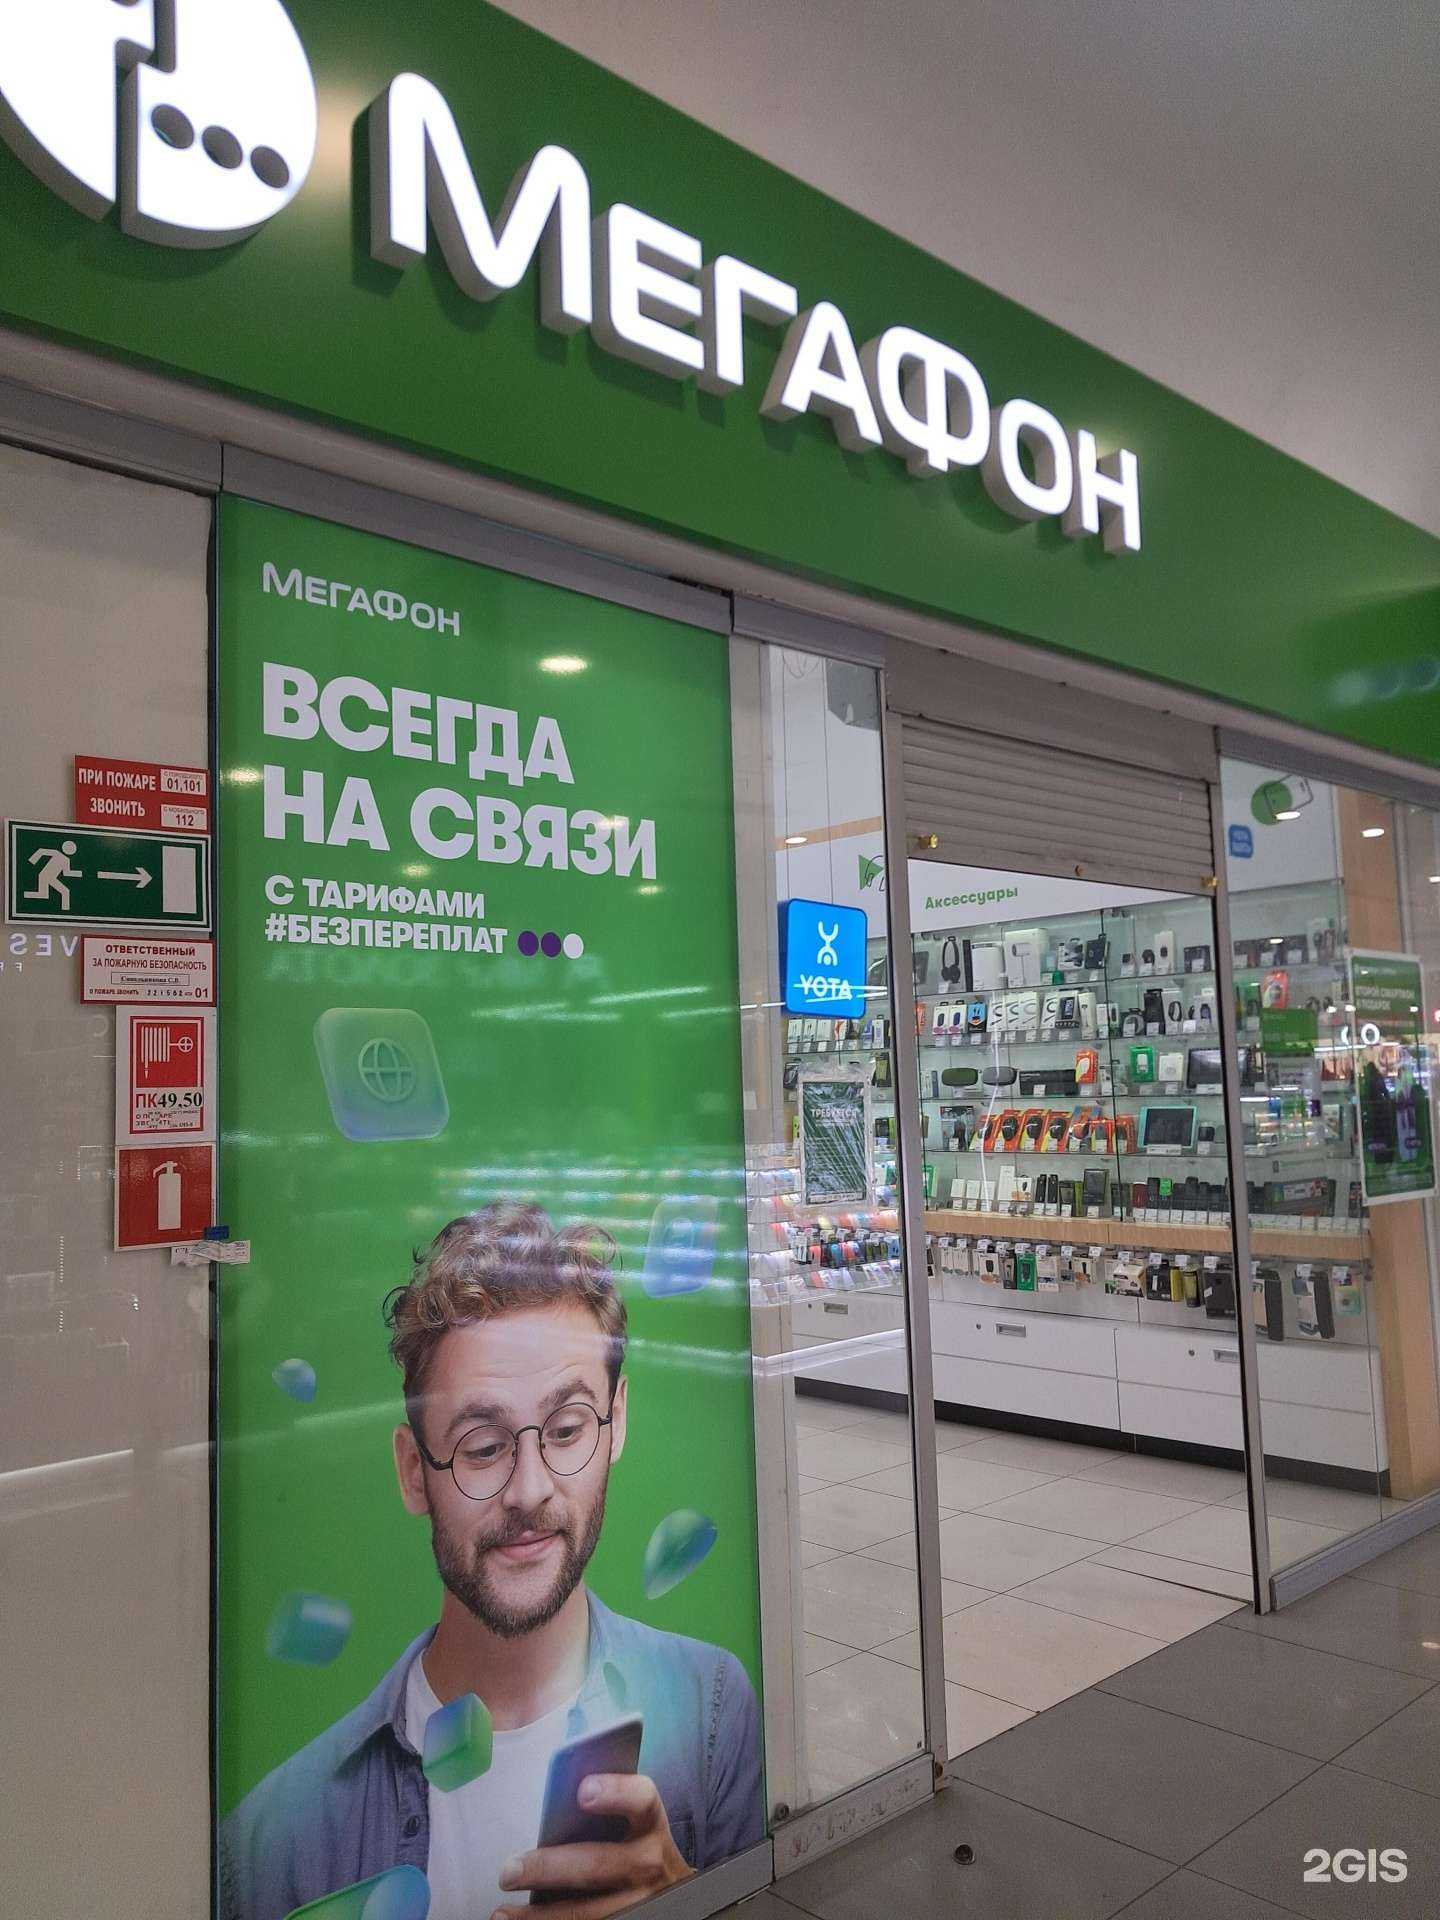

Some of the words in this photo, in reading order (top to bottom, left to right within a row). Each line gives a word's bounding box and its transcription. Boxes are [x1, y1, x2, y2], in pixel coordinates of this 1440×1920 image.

[263, 661, 575, 787] ВСЕГДА
[78, 767, 103, 786] ПРИ
[106, 771, 156, 791] ПОЖАРЕ
[167, 778, 201, 793] 01,101
[90, 797, 146, 817] ЗВОНИТЬ
[175, 814, 194, 826] 112
[263, 764, 390, 851] НА
[410, 787, 657, 880] СВЯЗИ
[264, 874, 294, 905] С
[302, 877, 485, 919] ТАРИФАМИ
[925, 887, 1018, 909] Аксессуары
[265, 912, 508, 954] #БЕЗПЕРЕПЛАТ
[105, 944, 196, 956] ОТВЕТСТВЕННЫЙ
[92, 958, 103, 967] ЗА
[104, 958, 148, 969] ПОЖАРНУЮ
[149, 960, 207, 971] БЕЗОПАСНОСТЬ
[194, 987, 209, 999] 01
[800, 974, 853, 1000] YOTA
